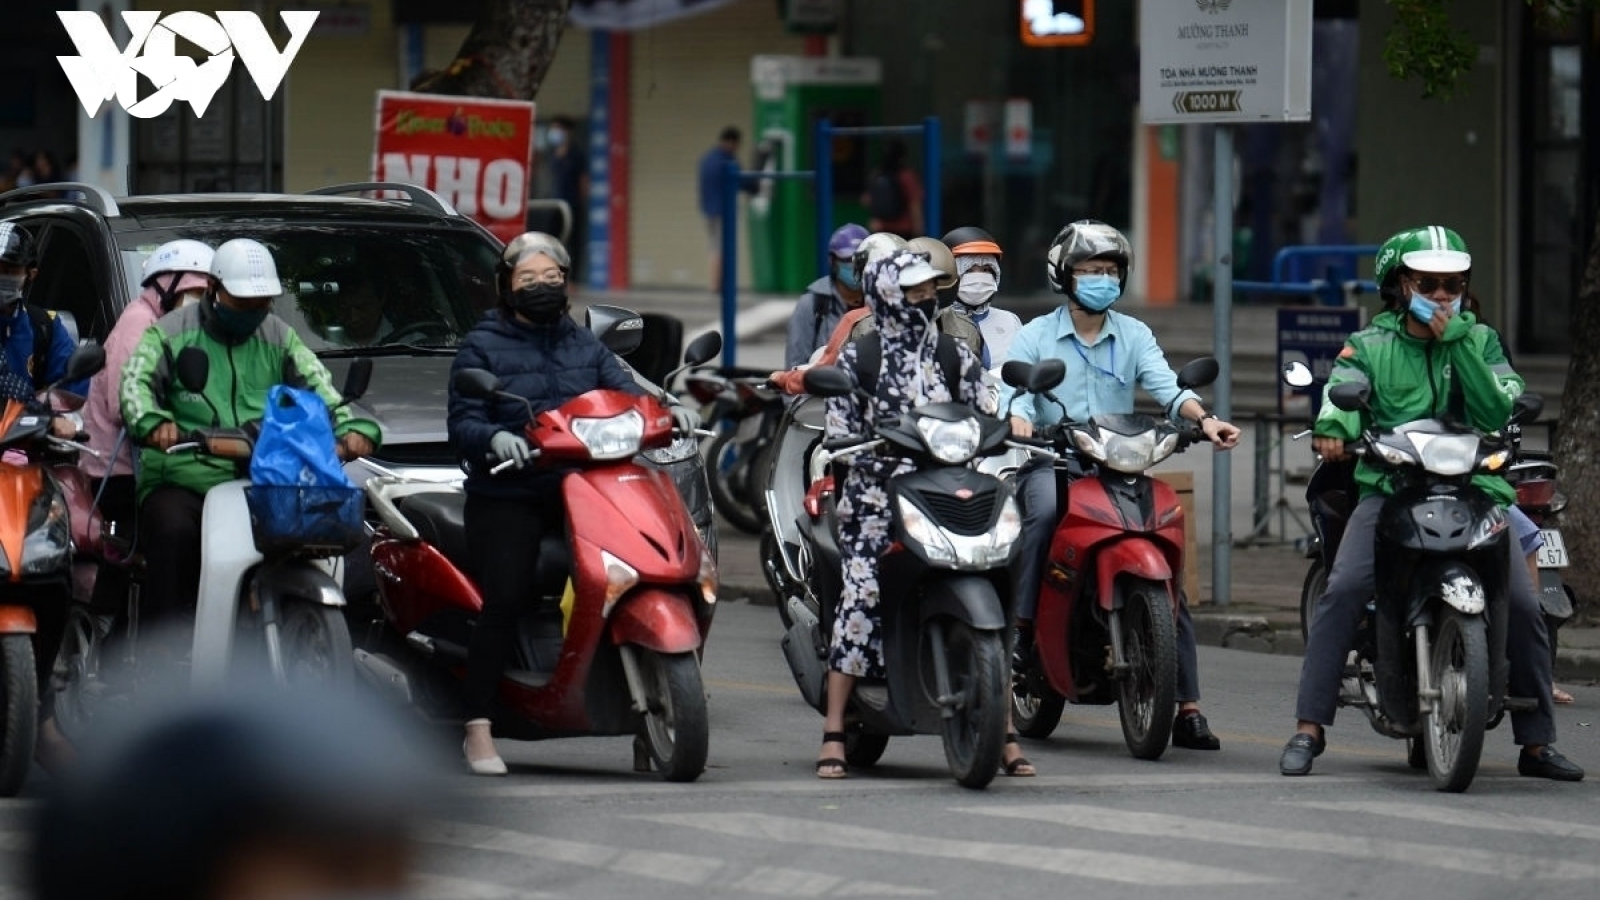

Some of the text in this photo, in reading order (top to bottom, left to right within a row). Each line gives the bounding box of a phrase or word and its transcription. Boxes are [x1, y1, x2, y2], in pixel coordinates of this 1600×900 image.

[1215, 23, 1249, 37] THANH
[1230, 65, 1258, 76] THANH
[1190, 93, 1230, 109] 1000 M
